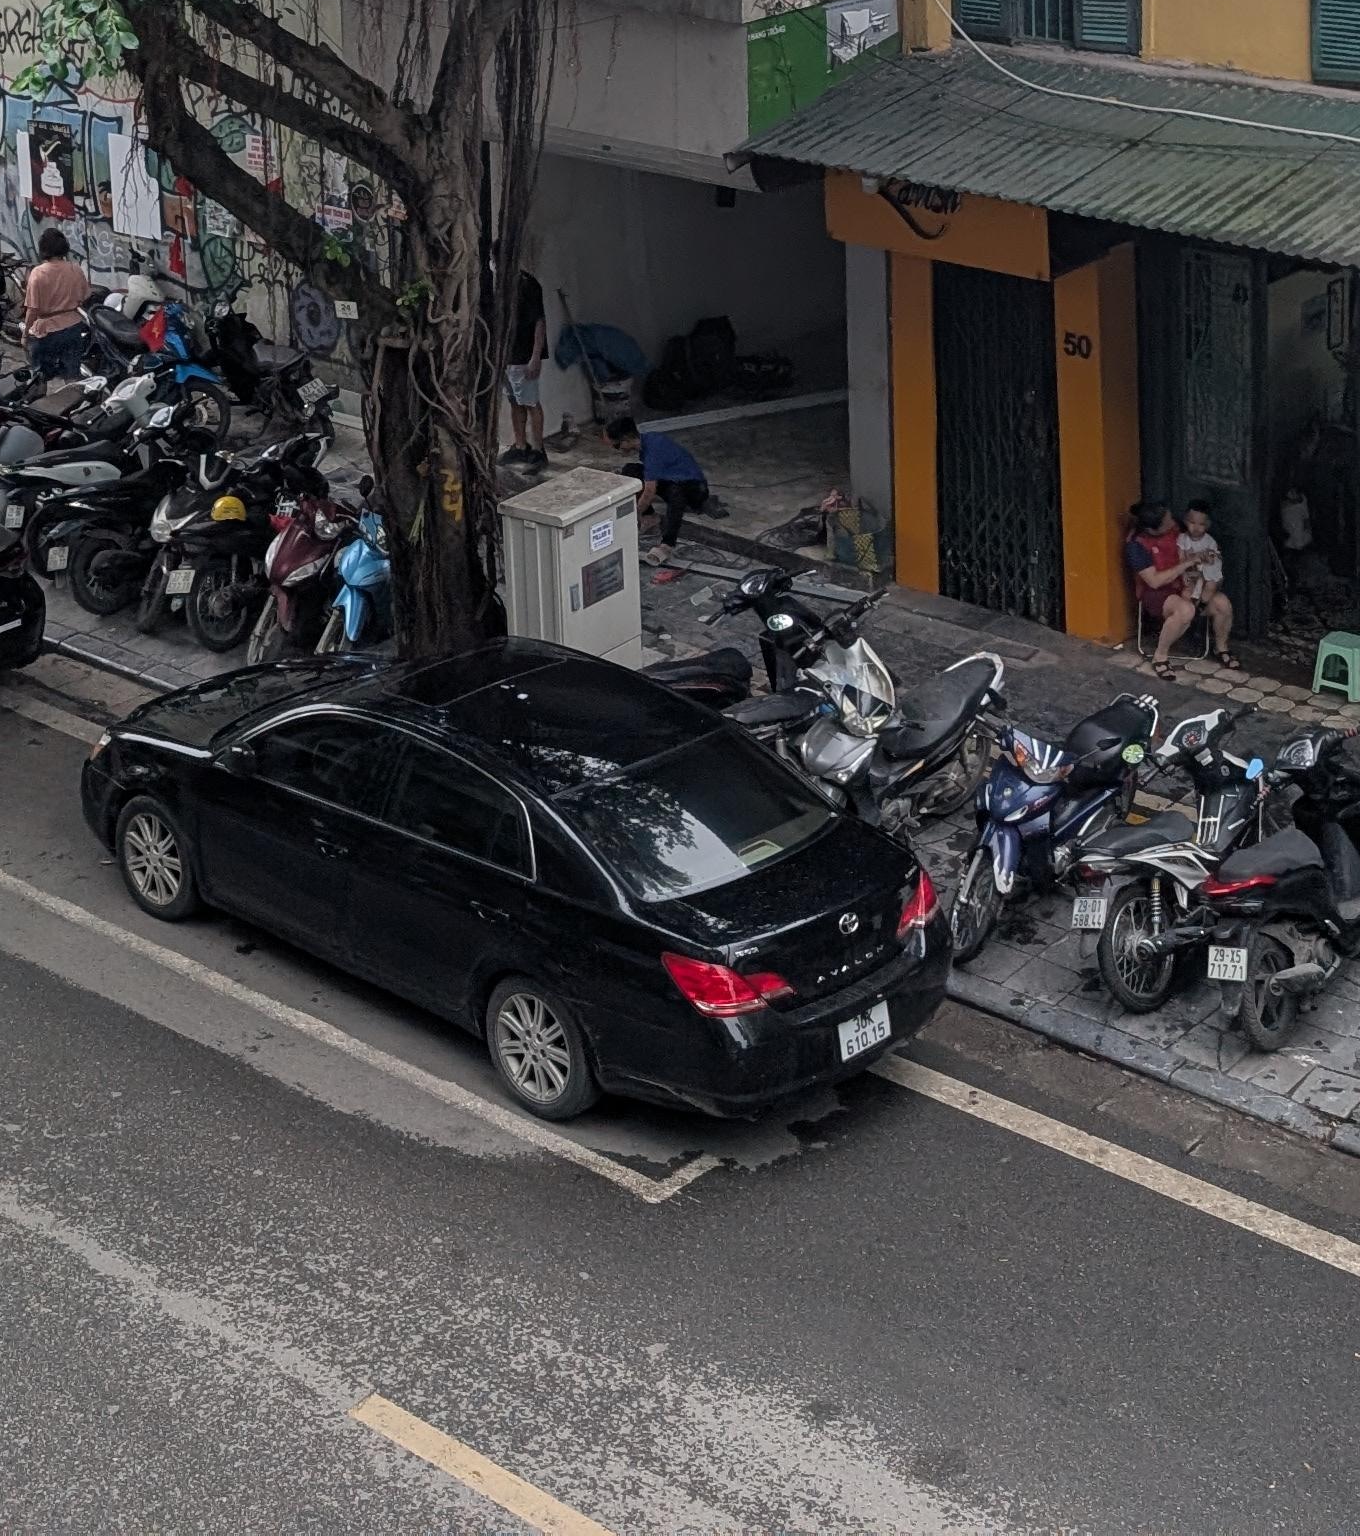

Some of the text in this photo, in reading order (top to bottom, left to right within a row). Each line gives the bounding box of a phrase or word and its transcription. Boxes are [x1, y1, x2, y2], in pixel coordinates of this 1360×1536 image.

[1063, 331, 1092, 360] 50
[816, 944, 884, 984] AVALON
[1210, 963, 1244, 980] 717.71
[846, 1021, 886, 1056] 610.15
